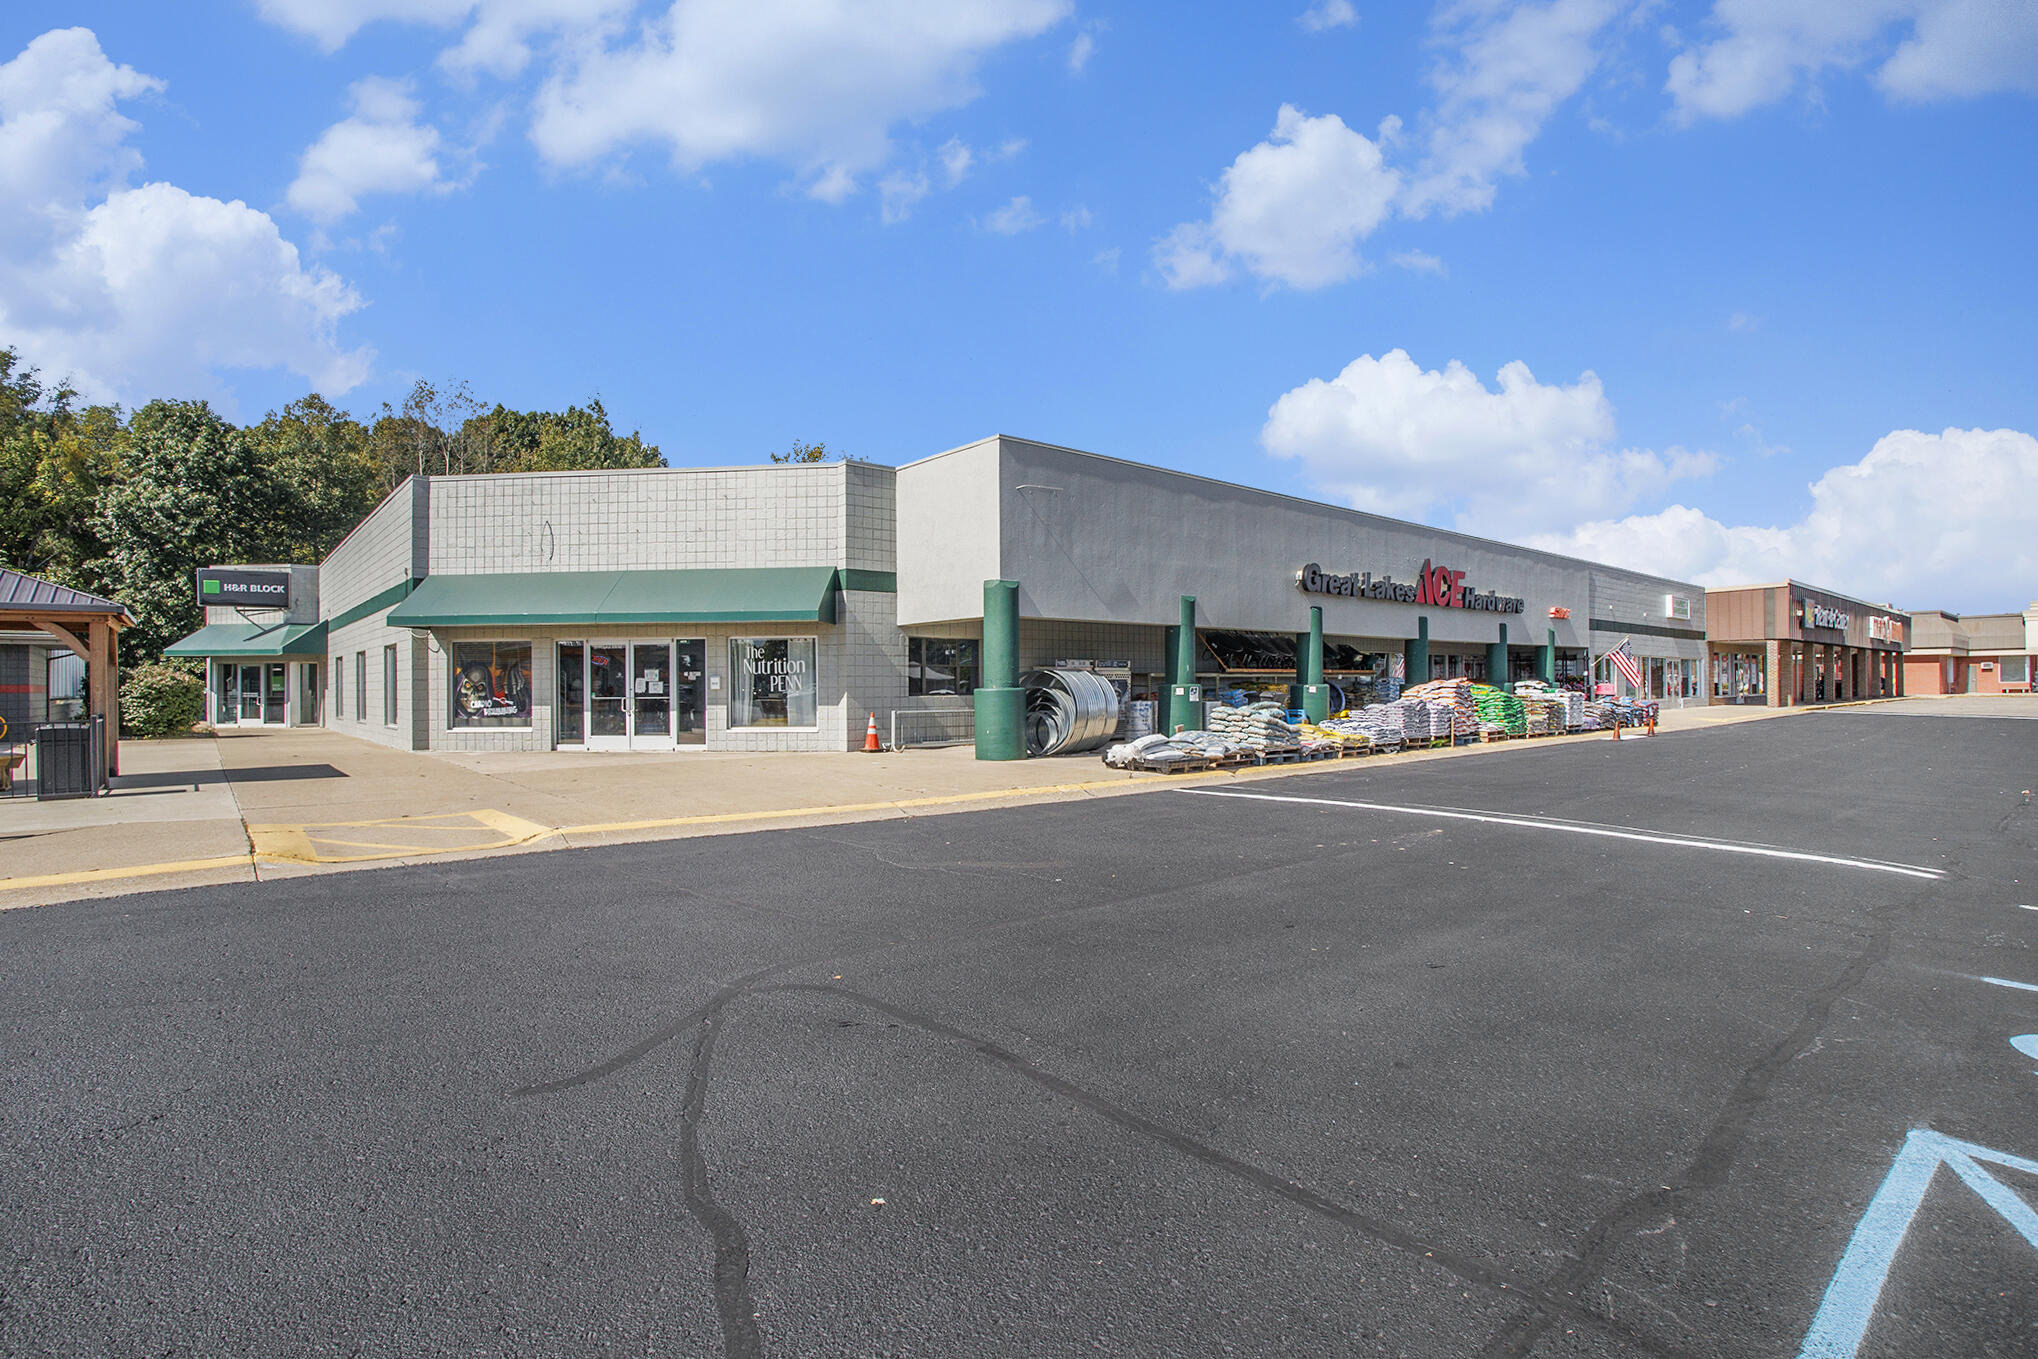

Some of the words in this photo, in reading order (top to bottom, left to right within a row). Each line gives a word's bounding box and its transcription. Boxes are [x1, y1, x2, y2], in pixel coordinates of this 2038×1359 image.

[223, 583, 248, 593] H&R
[249, 584, 286, 594] BLOCK
[1302, 562, 1360, 597] Great
[1361, 571, 1416, 603] Lakes
[1415, 558, 1466, 608] ACE
[1464, 586, 1525, 615] Hardware
[745, 645, 766, 659] The
[743, 657, 806, 675] Nutrition
[769, 674, 802, 693] PENN
